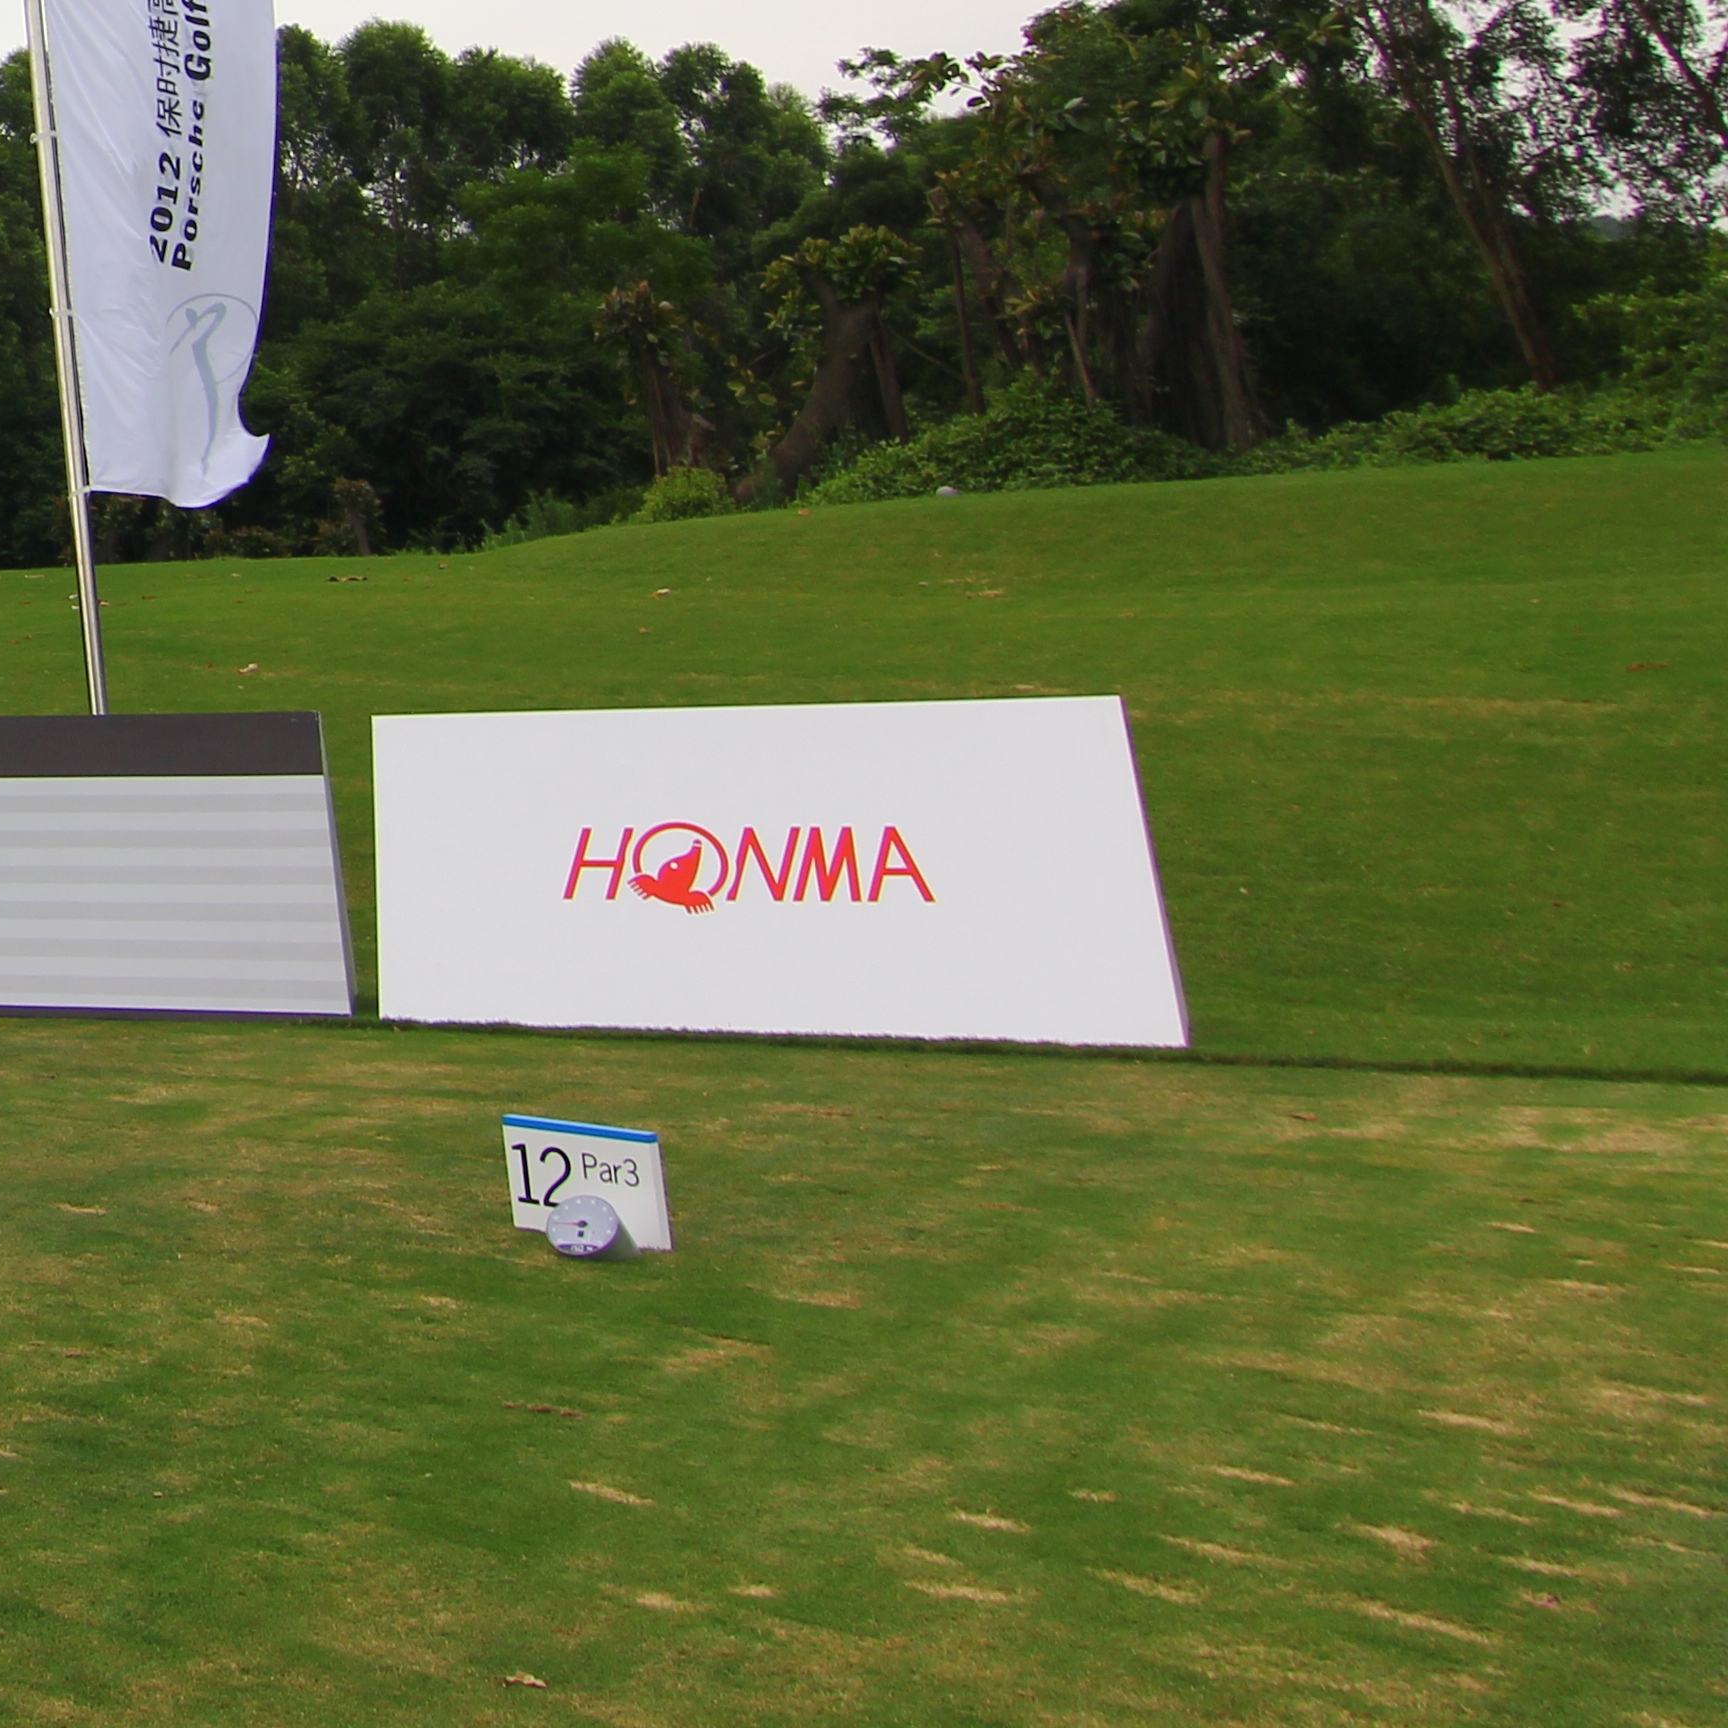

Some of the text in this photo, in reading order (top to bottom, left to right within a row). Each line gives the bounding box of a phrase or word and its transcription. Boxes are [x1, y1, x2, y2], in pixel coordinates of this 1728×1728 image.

[148, 151, 182, 264] 2012
[170, 98, 205, 271] Porsche
[562, 823, 937, 914] HONMA
[511, 1143, 641, 1208] 12 Par3
